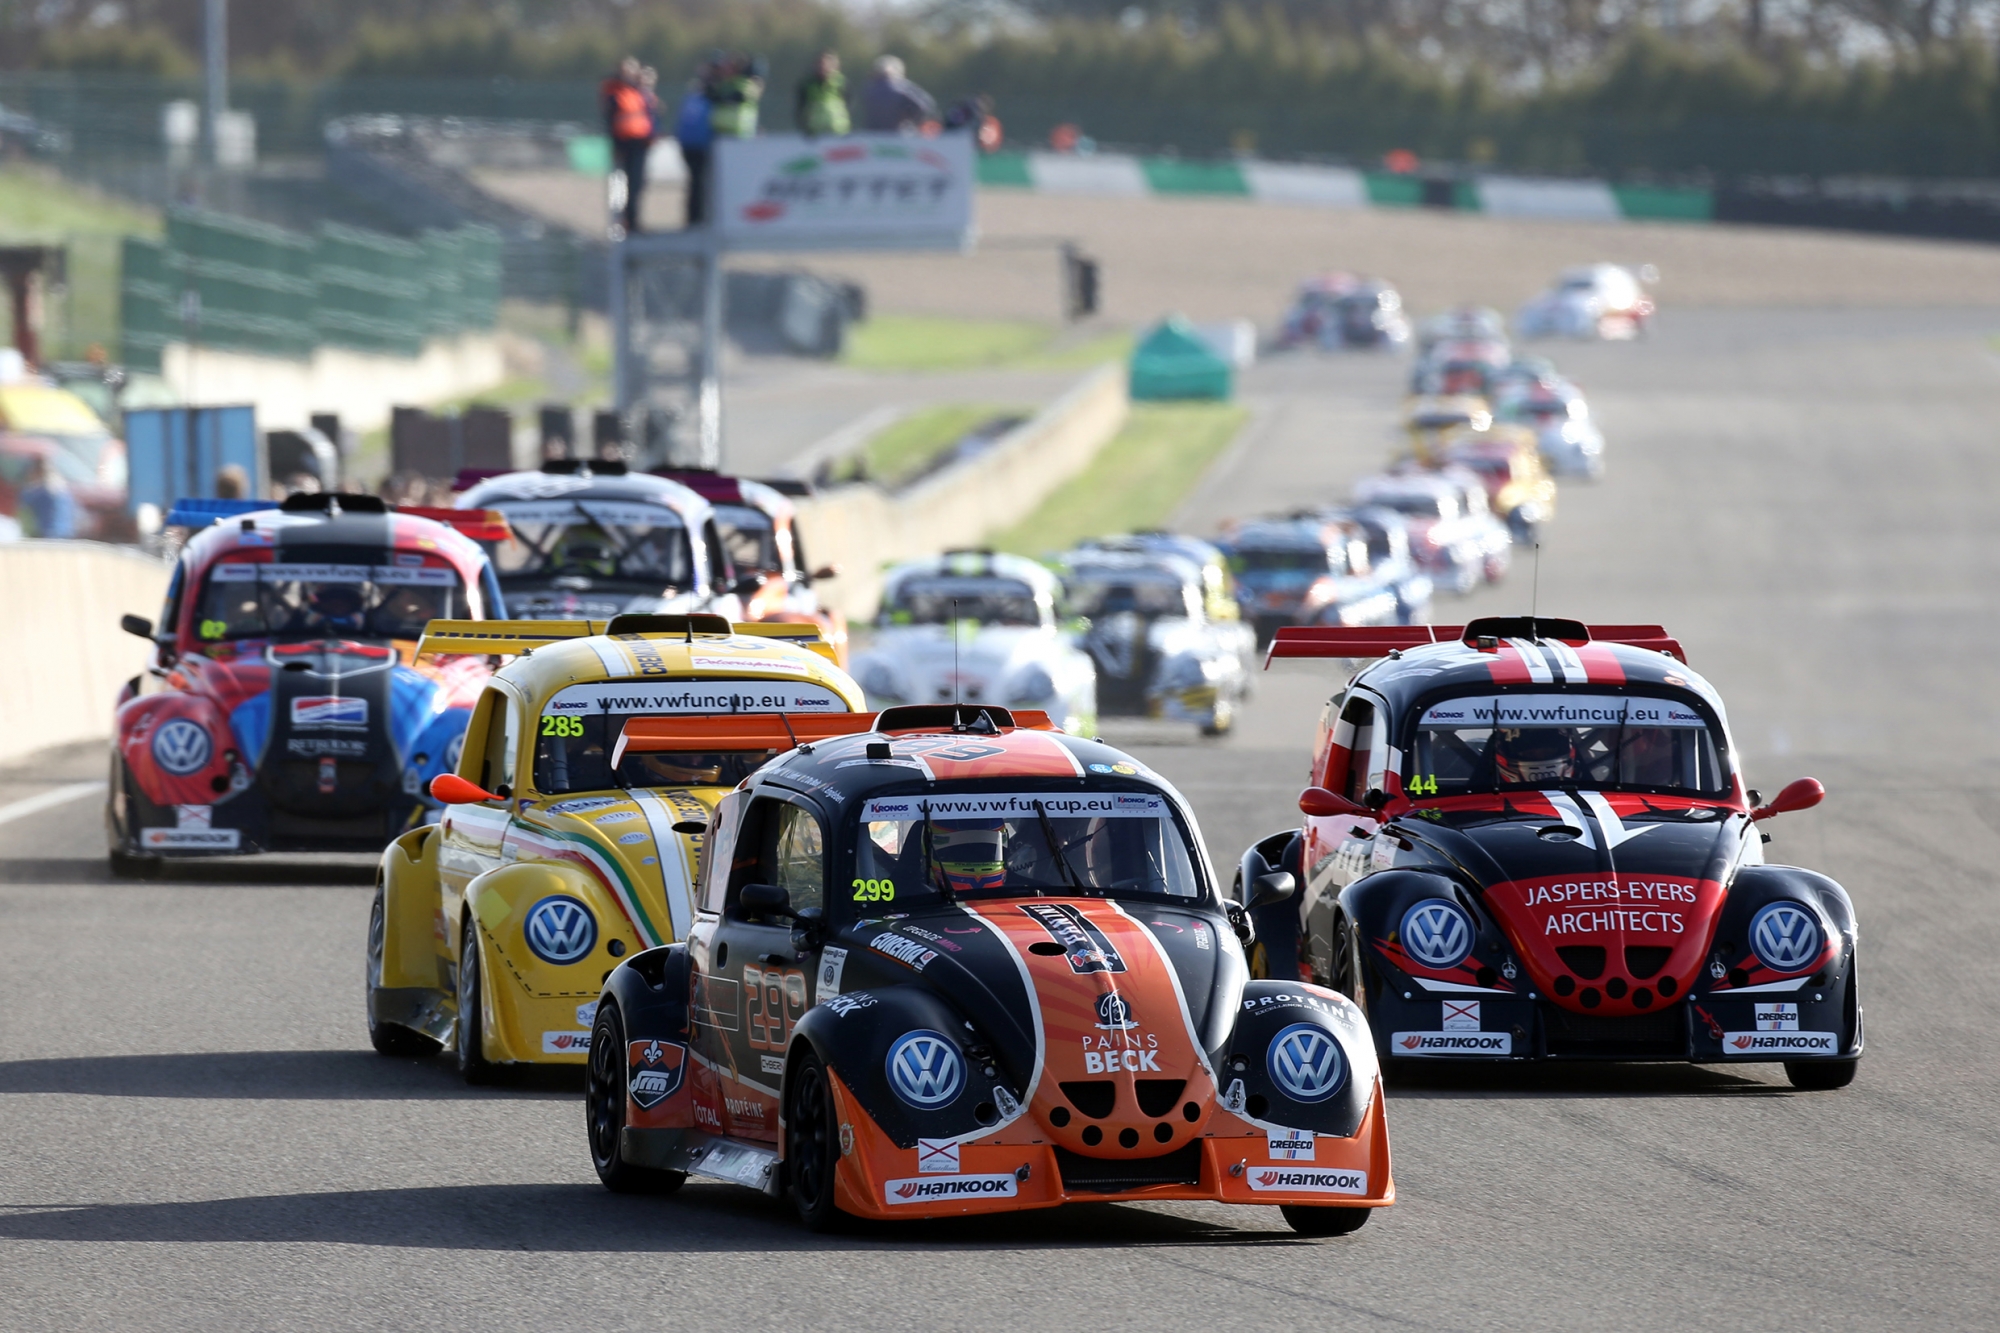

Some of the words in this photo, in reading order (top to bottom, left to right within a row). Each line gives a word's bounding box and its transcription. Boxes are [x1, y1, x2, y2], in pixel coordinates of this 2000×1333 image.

[552, 701, 588, 710] KRONOS
[597, 692, 786, 711] www.vwfuncup.eu
[794, 697, 830, 706] KRONOS
[1429, 710, 1464, 719] KRONOS
[1473, 706, 1660, 723] www.vwfuncup.eu
[541, 716, 584, 737] 285
[1409, 774, 1438, 795] 44
[871, 802, 909, 813] KRONOS
[917, 797, 1113, 814] www.vwfuncup.eu
[1117, 795, 1146, 805] KRONOS
[851, 879, 895, 902] 299
[1525, 881, 1697, 906] JASPERS-EYERS
[1545, 911, 1685, 936] ARCHITECTS
[744, 963, 809, 1052] 299
[1243, 994, 1359, 1024] PROTÉINE
[1757, 1012, 1797, 1021] CREDECO
[1082, 1033, 1158, 1050] PAINS
[1084, 1050, 1162, 1074] BECK
[692, 1099, 721, 1127] TOTAL
[1269, 1139, 1313, 1150] CREDECO
